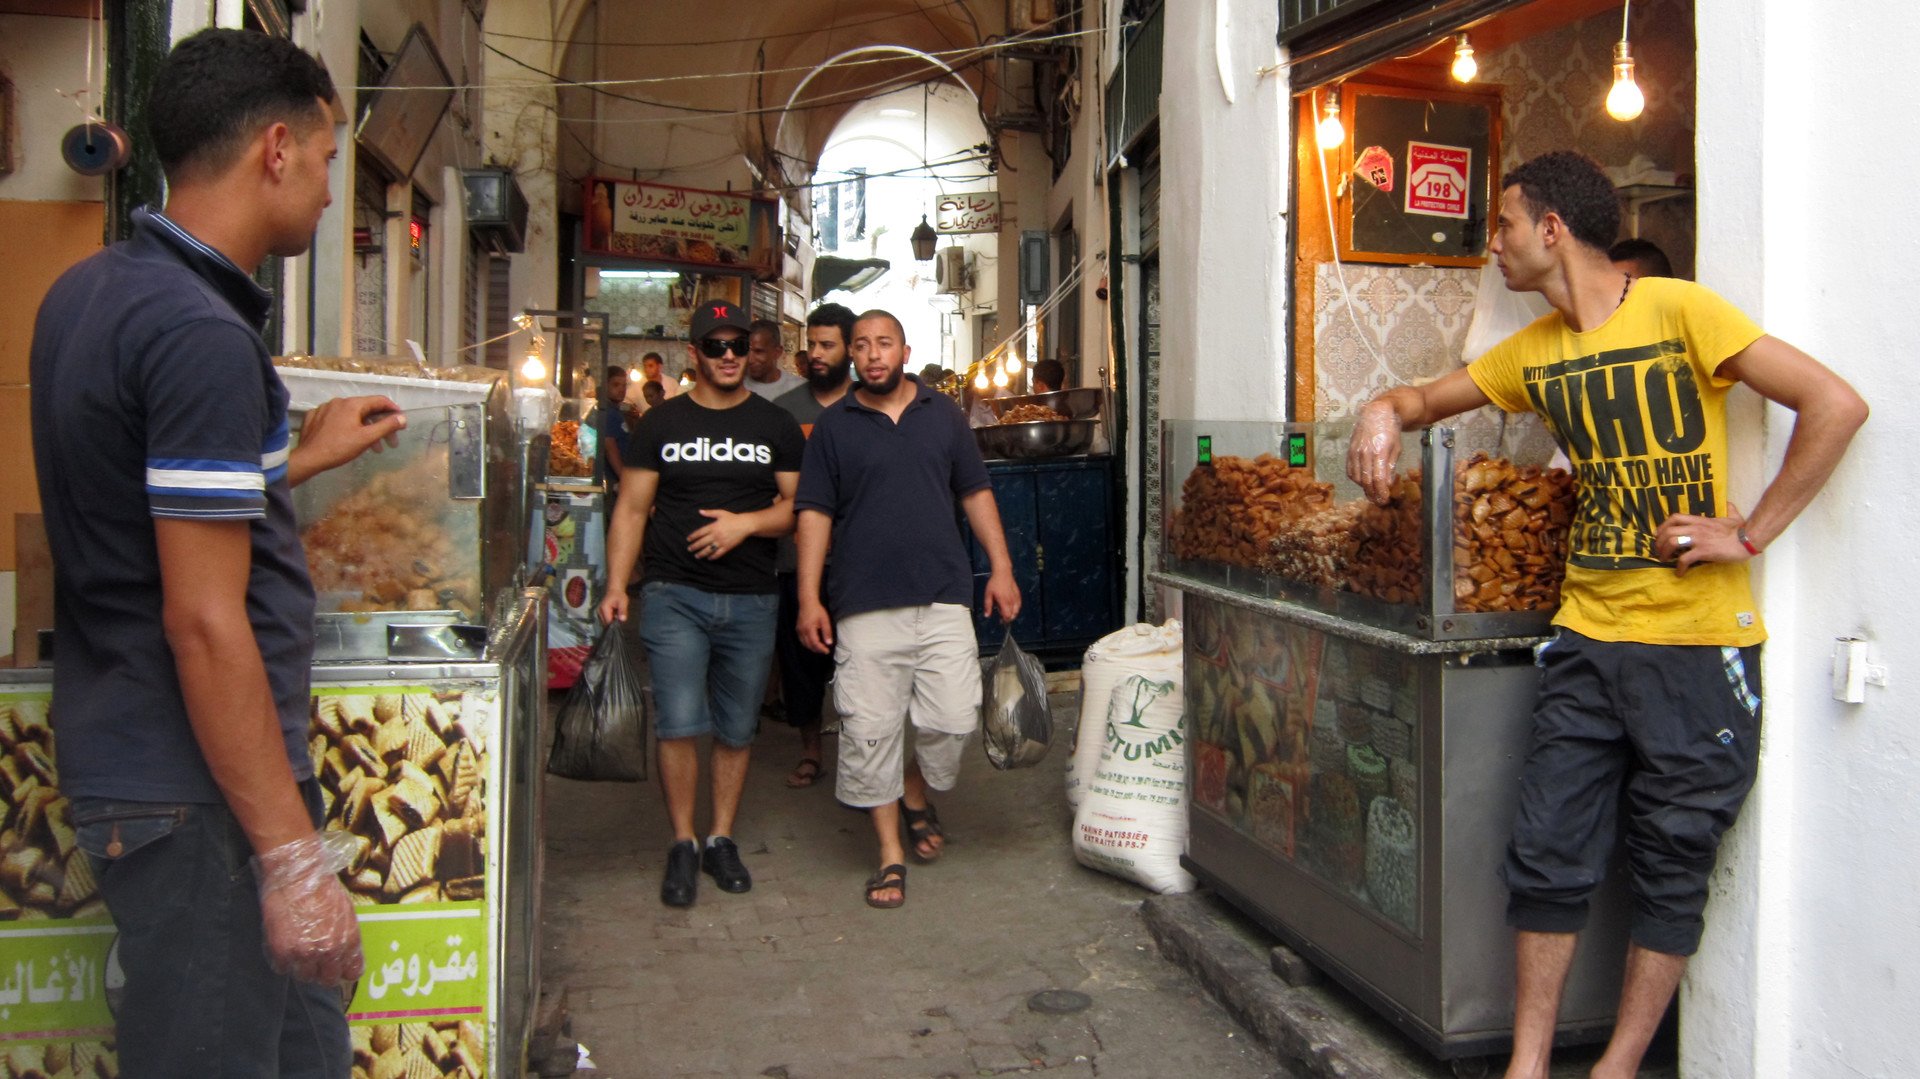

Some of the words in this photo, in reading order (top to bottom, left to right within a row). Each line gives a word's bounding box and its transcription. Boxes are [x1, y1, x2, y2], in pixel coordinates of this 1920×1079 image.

[623, 182, 686, 211] القيروان
[1427, 181, 1450, 198] 198
[689, 196, 744, 218] مقروض
[1420, 200, 1446, 210] PROTECTION
[1523, 365, 1550, 381] WITH
[1526, 354, 1706, 460] WHO
[661, 437, 772, 464] adidas
[1623, 460, 1651, 487] TO
[1654, 453, 1714, 485] HAVE
[1588, 524, 1628, 555] GET
[1081, 824, 1103, 836] FARINE
[1084, 834, 1116, 847] EXTRAITE
[368, 934, 479, 1000] مقروض
[0, 948, 97, 1020] الأغالب
